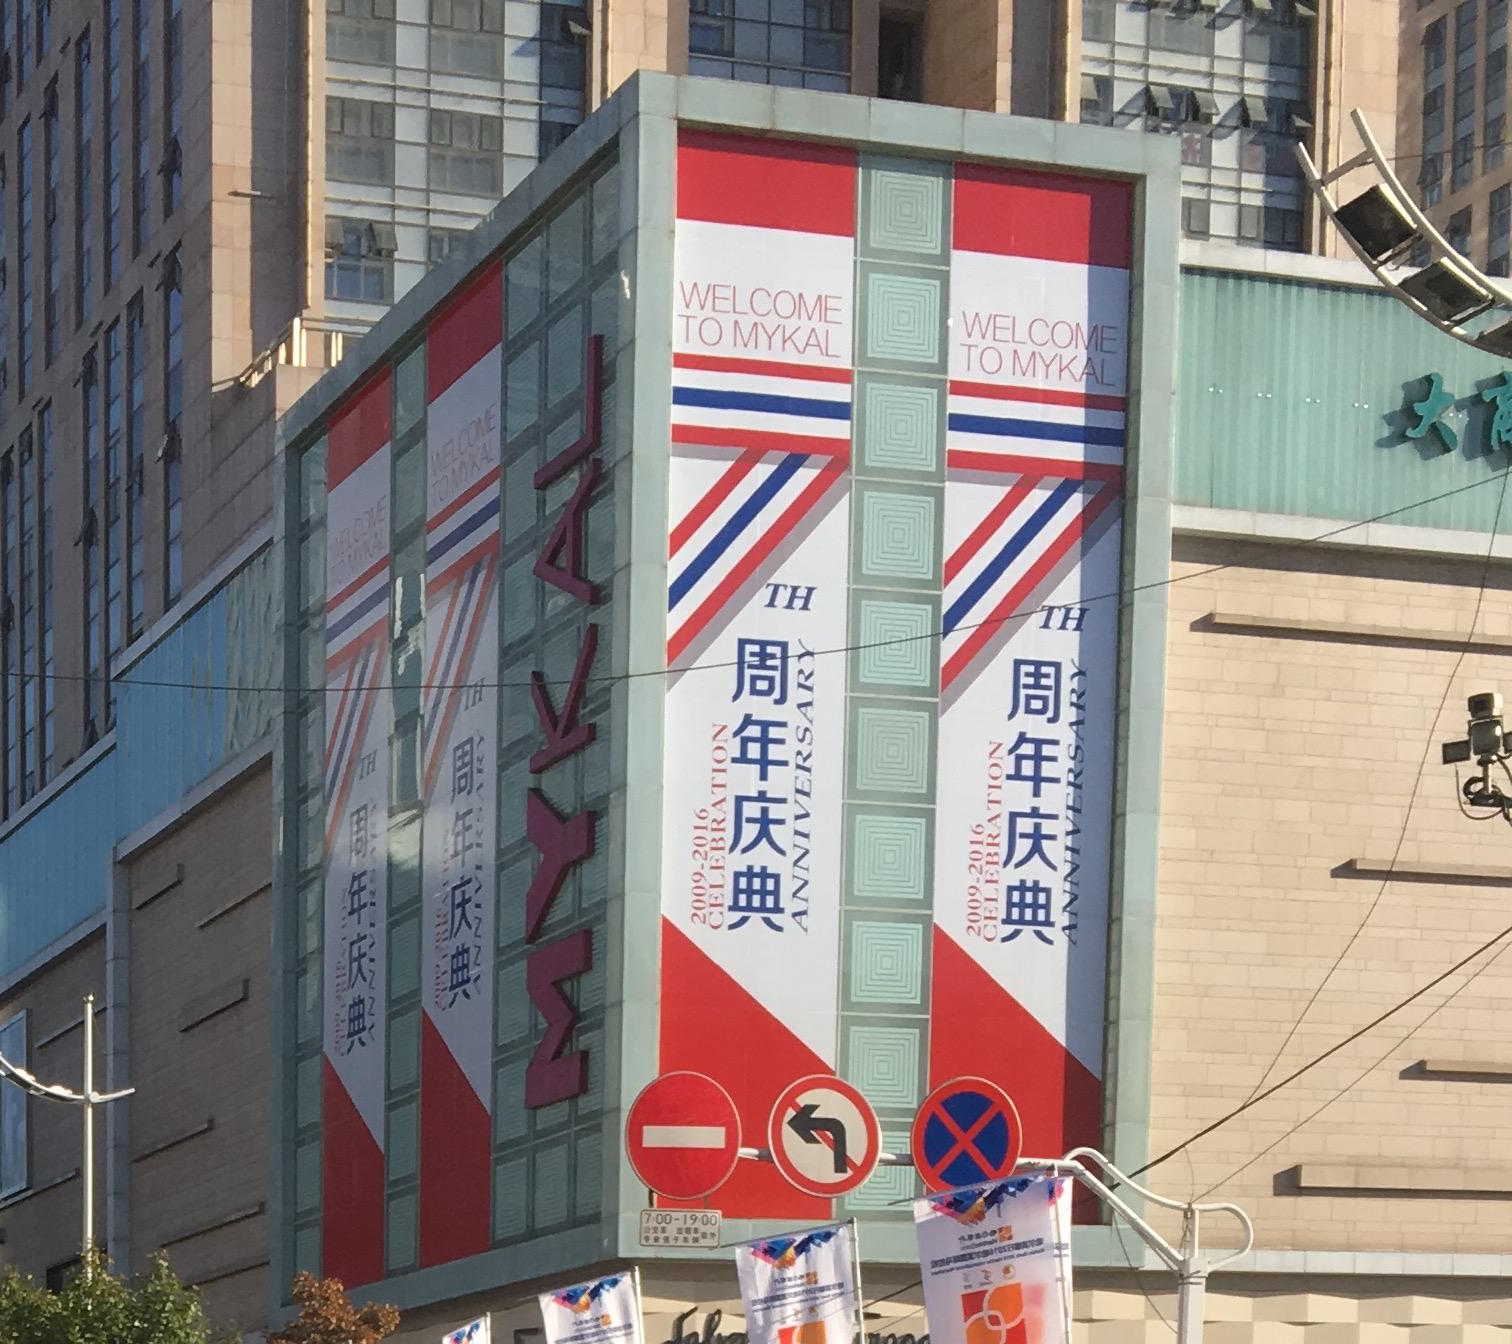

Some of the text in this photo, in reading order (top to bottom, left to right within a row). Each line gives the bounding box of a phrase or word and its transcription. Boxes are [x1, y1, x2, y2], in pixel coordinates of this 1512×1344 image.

[678, 314, 841, 359] TO MYKAL
[679, 280, 843, 326] WELCOME
[960, 344, 1116, 388] TO MYKAL
[962, 310, 1117, 355] WELCOME
[764, 583, 817, 612] TH
[1038, 605, 1090, 632] TH
[524, 334, 605, 1110] MYKAL
[727, 636, 790, 933] 周年庆典
[791, 637, 817, 935] ANNIVERSARY
[1000, 657, 1063, 947] 周年庆典
[1061, 657, 1089, 947] ANNIVERSARY
[346, 803, 369, 1056] 周年庆典
[447, 736, 474, 1010] 周年庆典
[691, 806, 709, 926] 2009-2016
[708, 722, 730, 932] CELEBRATION
[966, 822, 985, 937] 2009-2016
[983, 739, 1005, 945] CELEBRATION
